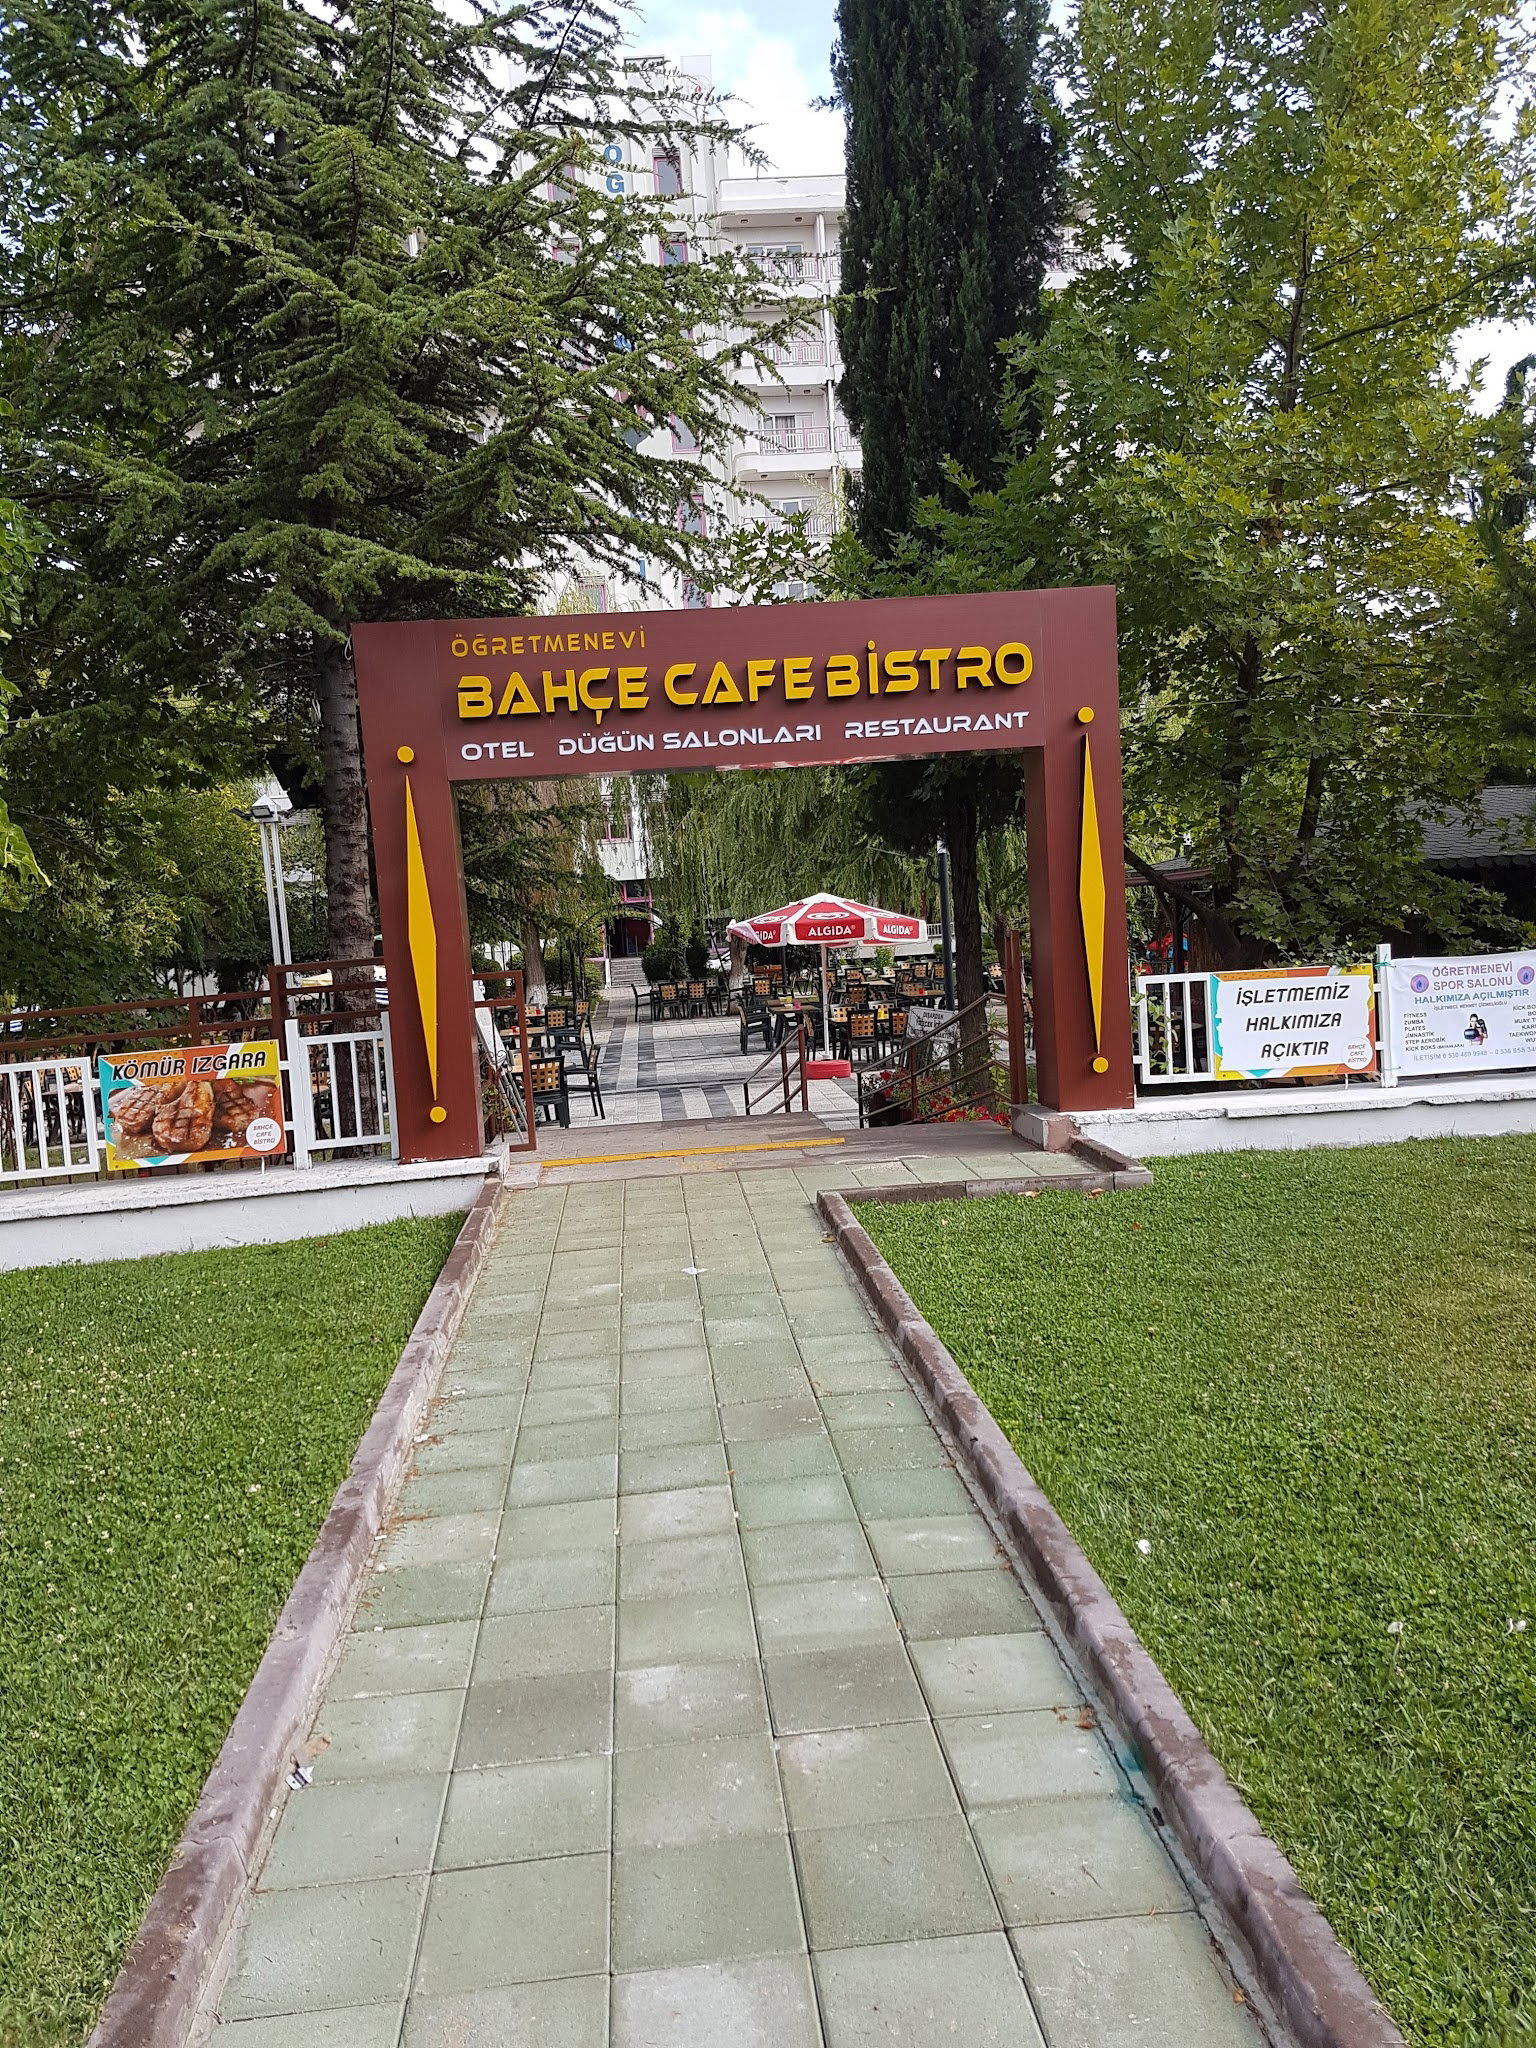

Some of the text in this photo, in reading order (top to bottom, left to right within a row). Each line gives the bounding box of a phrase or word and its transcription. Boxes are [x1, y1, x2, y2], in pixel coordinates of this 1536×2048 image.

[451, 625, 646, 658] ÖĞRETMENEVİ
[457, 640, 1034, 725] BAHÇE CAFE BİSTRO
[461, 711, 1030, 761] OTEL DÜĞÜN SALONLARI RESTAURANT
[1432, 961, 1513, 977] ÖĞRETMENEVİ
[1433, 976, 1513, 991] SPOR SALONU
[1236, 982, 1350, 1006] İŞLETMEMİZ
[1414, 989, 1529, 1004] HALKIMIZA AÇILMIŞTIR
[1246, 1013, 1342, 1031] HALKIMIZA
[1261, 1041, 1329, 1061] AÇIKTIR
[1413, 1053, 1441, 1061] İLETİŞİM
[112, 1051, 266, 1080] KÖMÜR IZGARA
